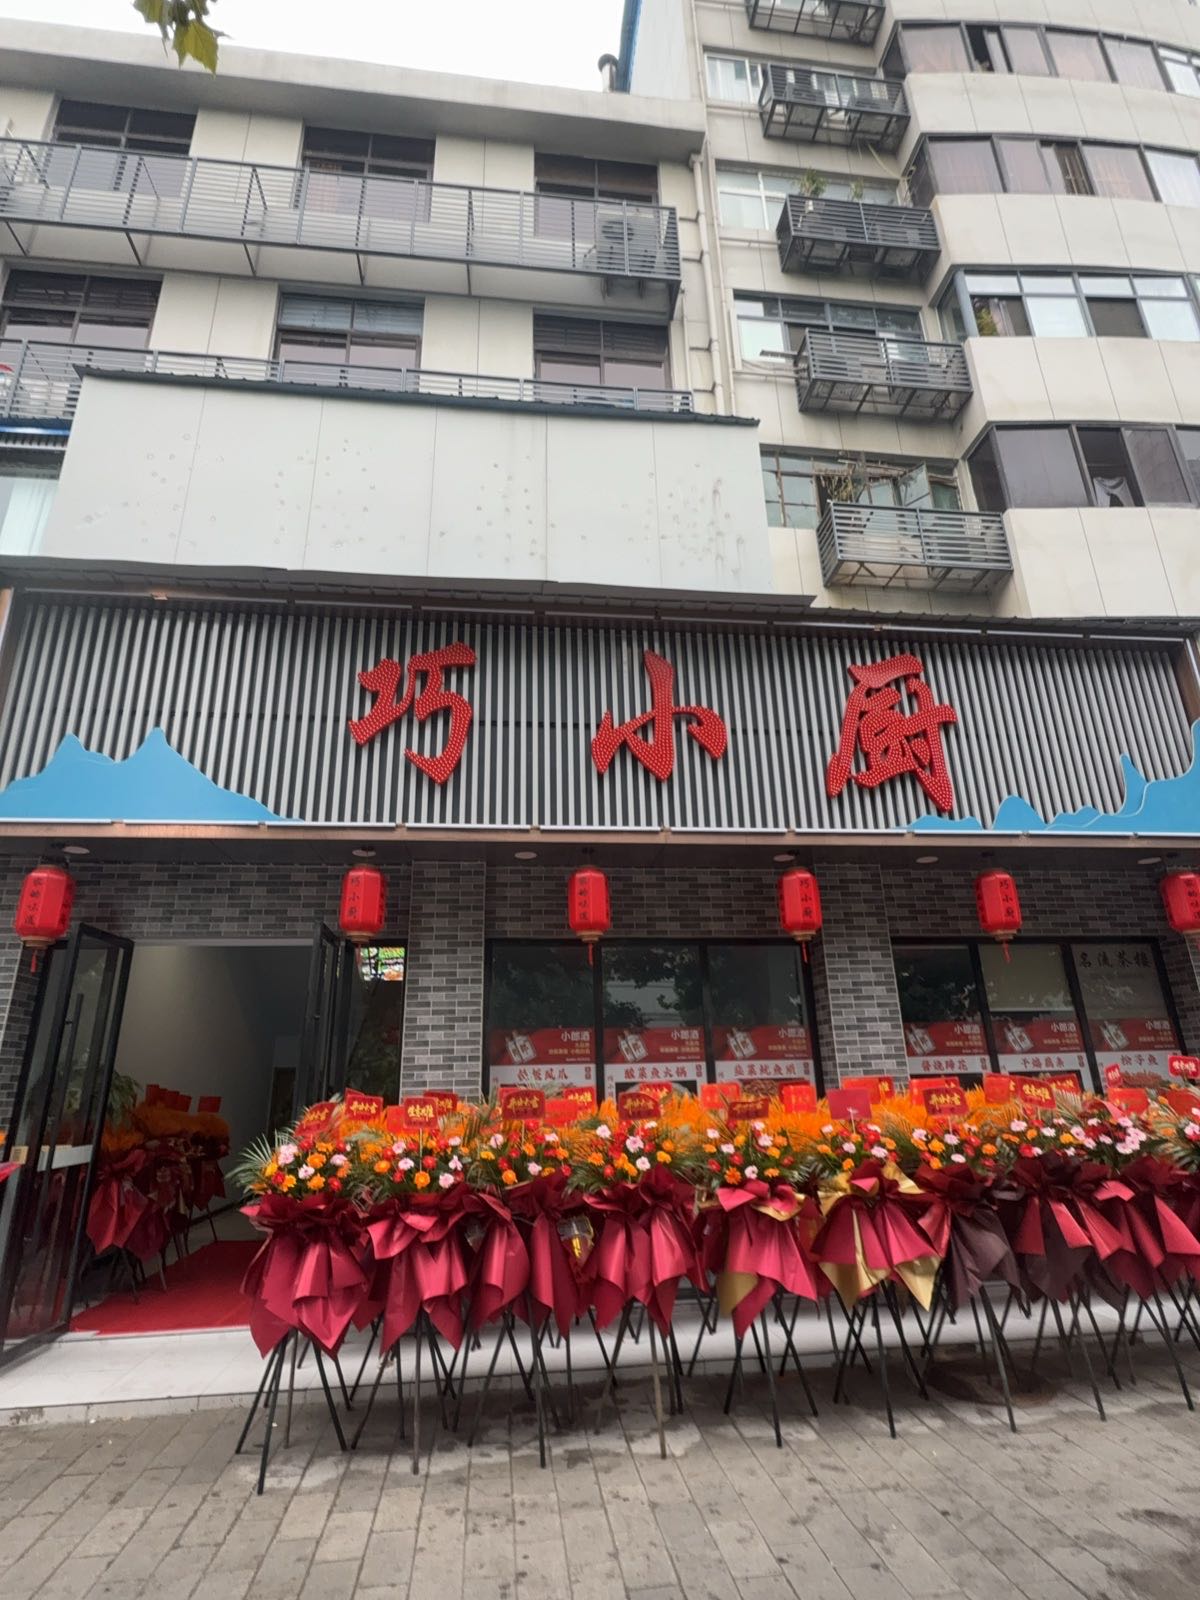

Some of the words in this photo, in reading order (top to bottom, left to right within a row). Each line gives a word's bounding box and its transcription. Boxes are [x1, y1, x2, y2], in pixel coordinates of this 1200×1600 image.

[347, 642, 957, 814] 巧小厨
[799, 879, 813, 919] 巧小厨
[999, 880, 1015, 918] 巧小厨
[561, 1030, 590, 1042] 小郎酒
